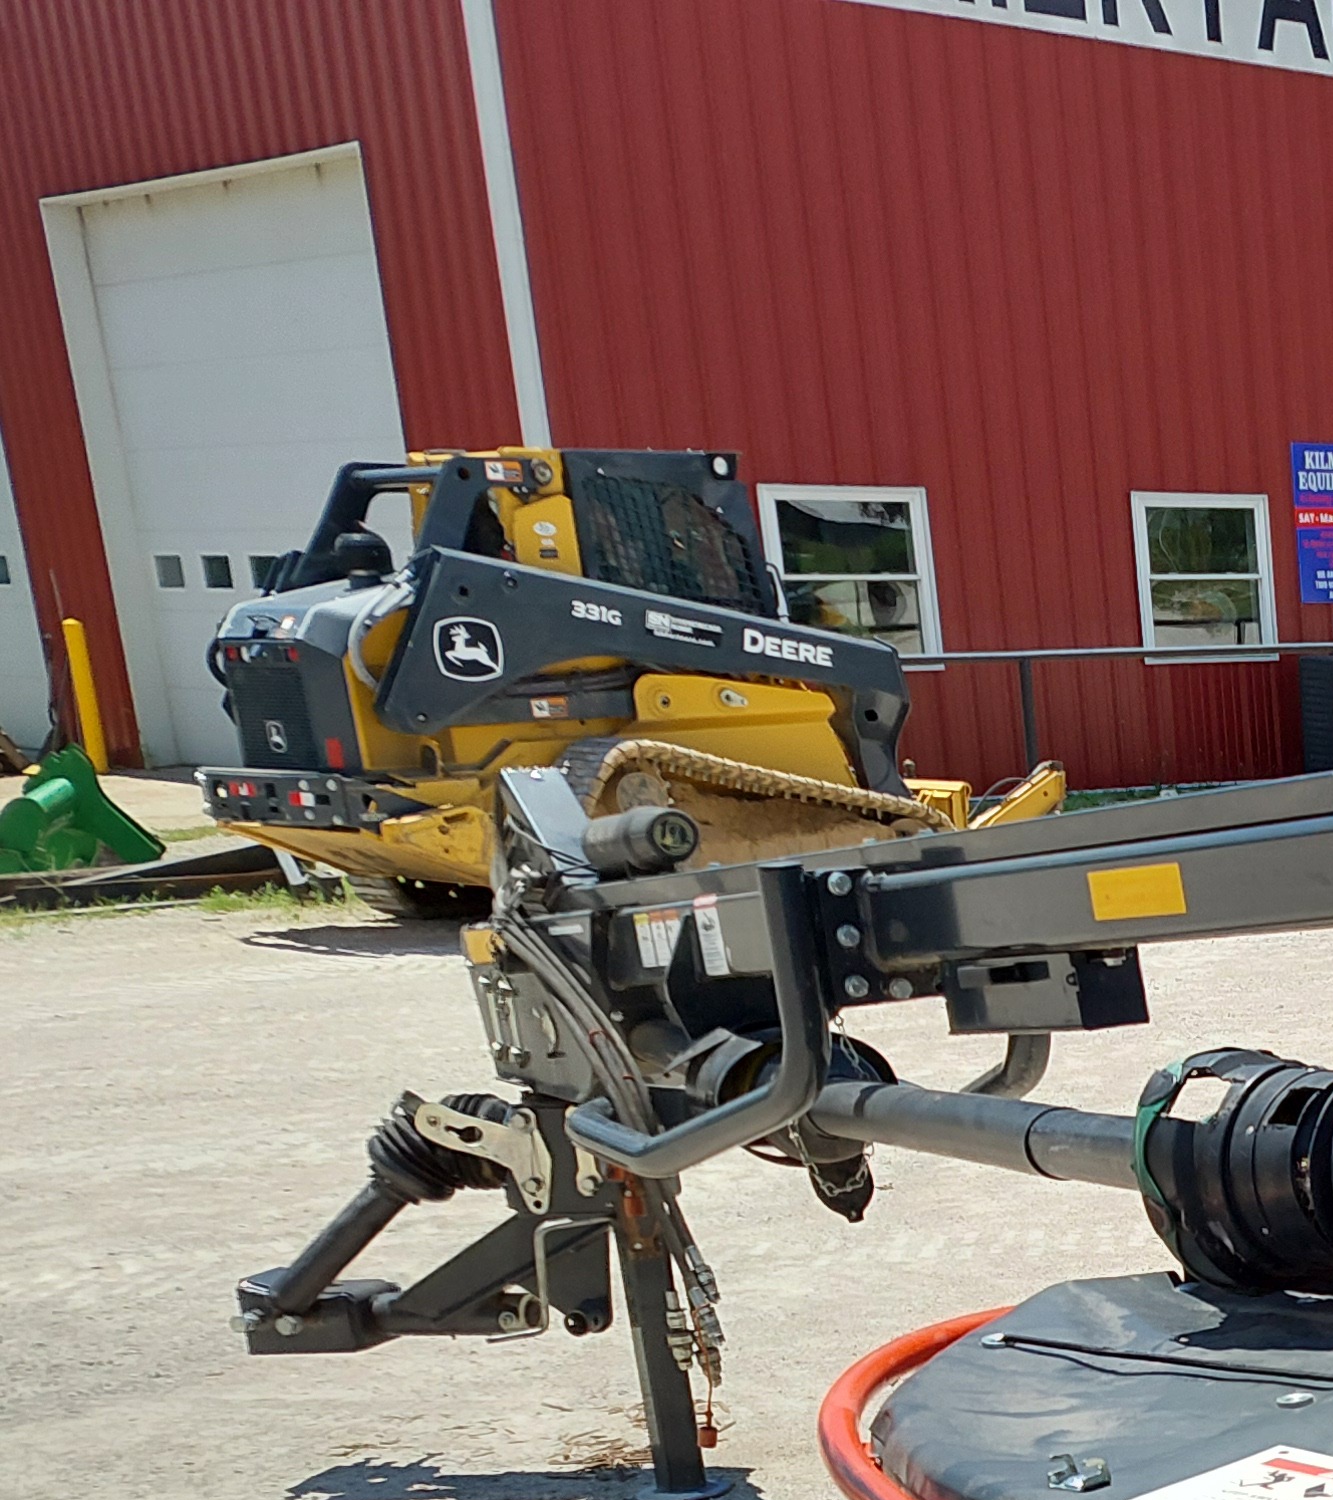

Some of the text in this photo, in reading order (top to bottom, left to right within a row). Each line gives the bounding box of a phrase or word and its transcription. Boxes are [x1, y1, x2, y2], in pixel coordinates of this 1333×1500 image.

[1298, 512, 1315, 524] SAT
[571, 600, 623, 626] 331G
[743, 628, 834, 668] DEERE
